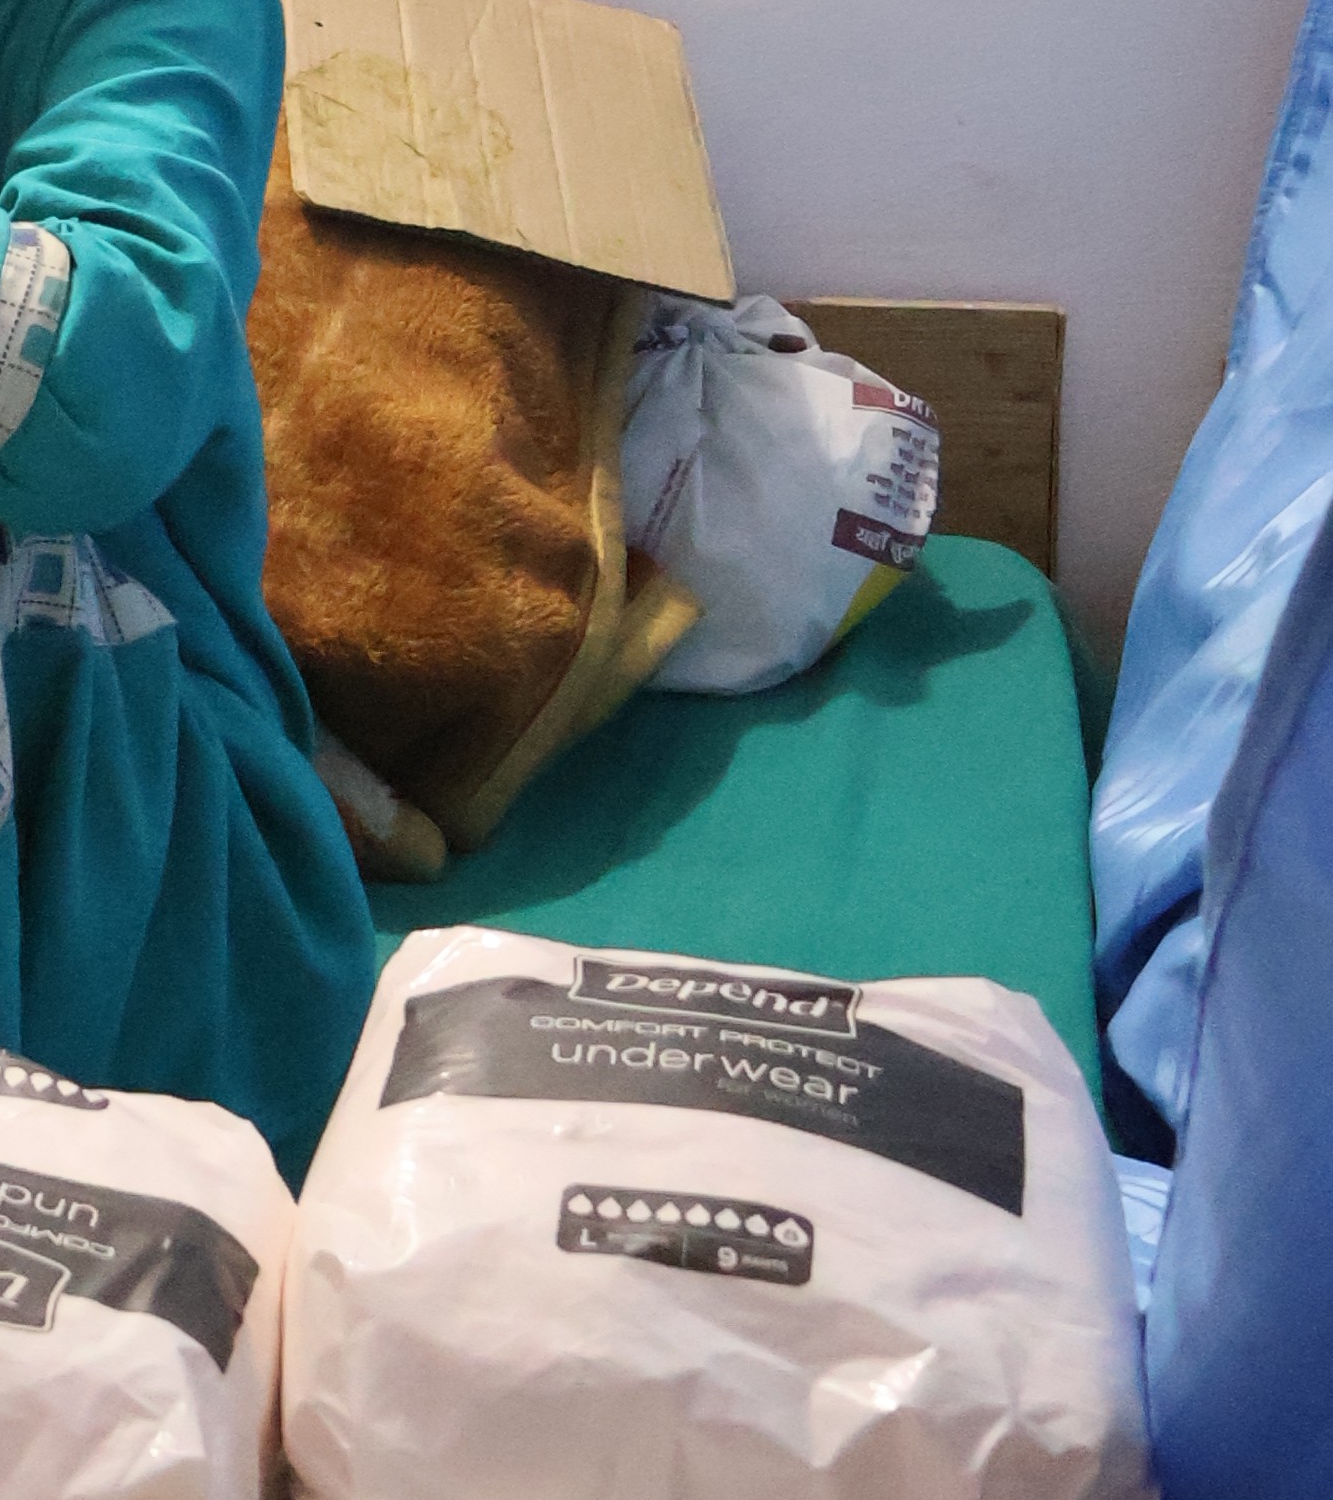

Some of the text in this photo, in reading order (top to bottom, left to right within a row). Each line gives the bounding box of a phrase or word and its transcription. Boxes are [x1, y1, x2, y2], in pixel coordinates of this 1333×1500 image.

[605, 973, 829, 1018] Depend
[530, 1016, 883, 1079] COMFORT PROTECT
[551, 1042, 859, 1105] underwear
